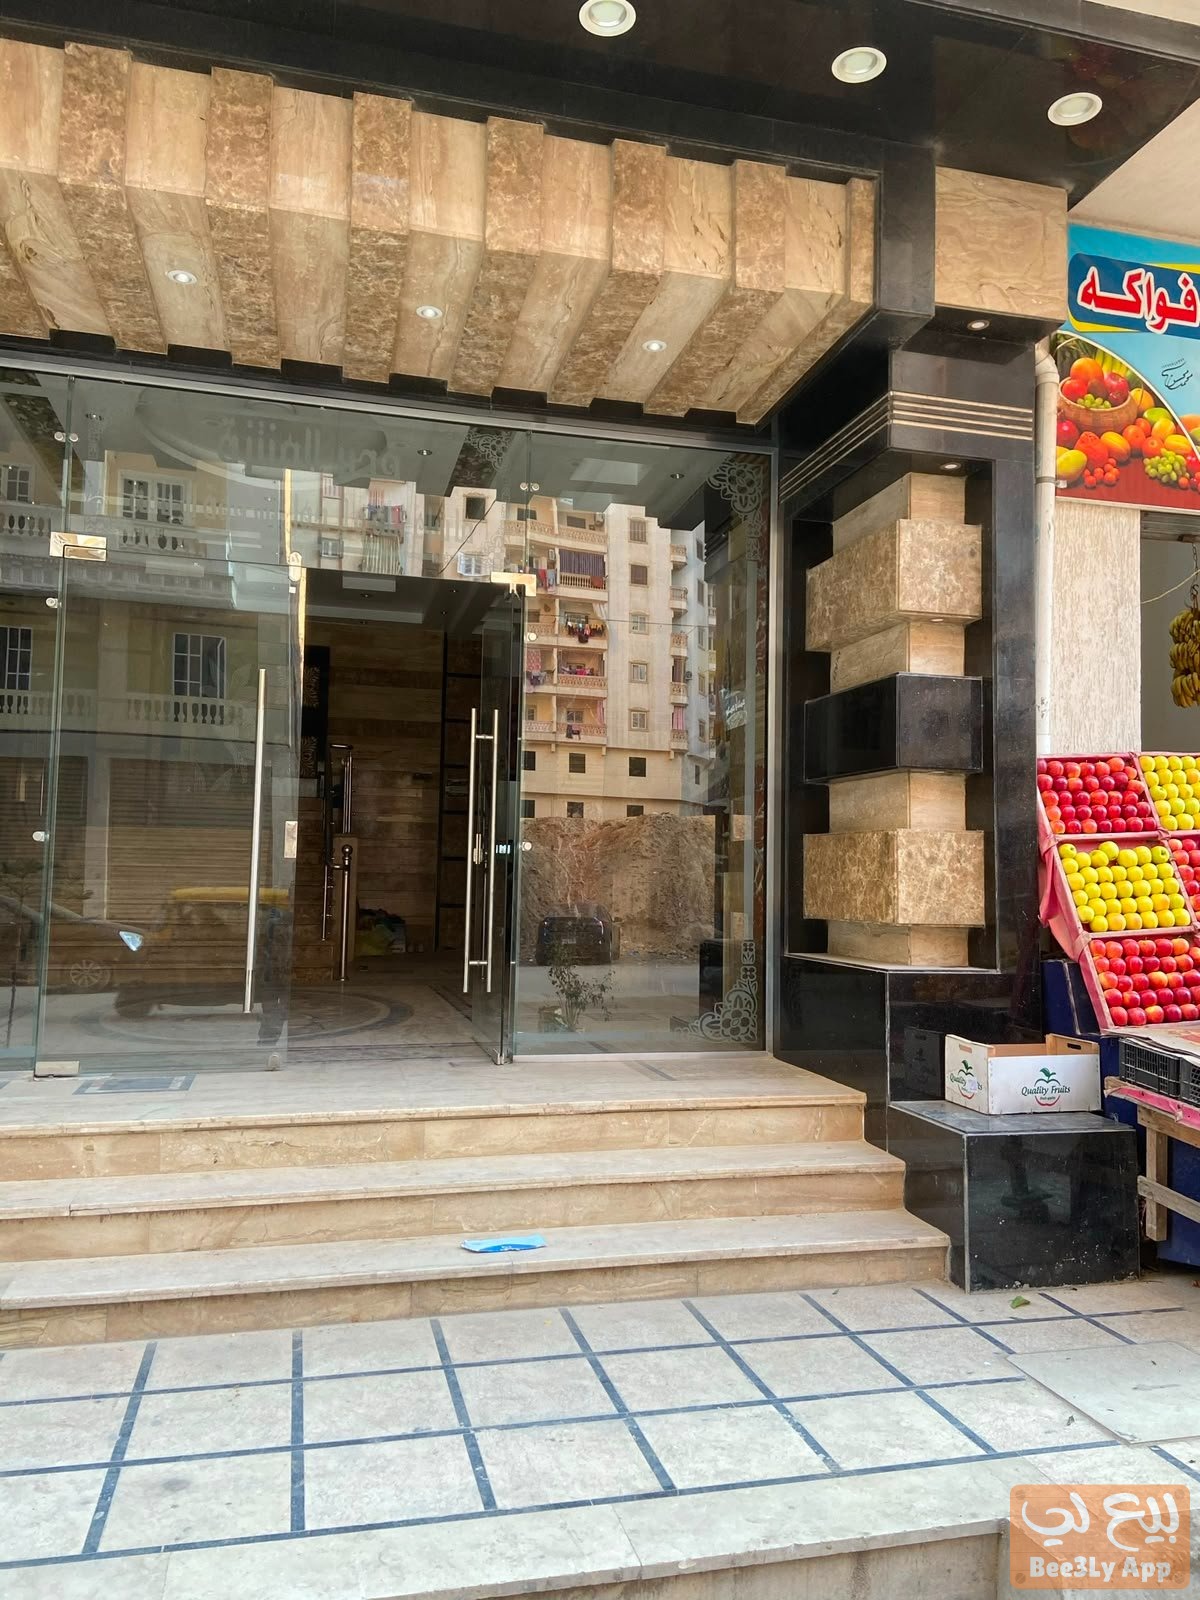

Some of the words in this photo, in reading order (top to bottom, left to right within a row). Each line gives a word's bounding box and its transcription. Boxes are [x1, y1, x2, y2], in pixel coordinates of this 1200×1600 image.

[1078, 267, 1199, 333] فواكه
[1021, 1086, 1049, 1096] Quality
[1051, 1085, 1071, 1094] Fruits
